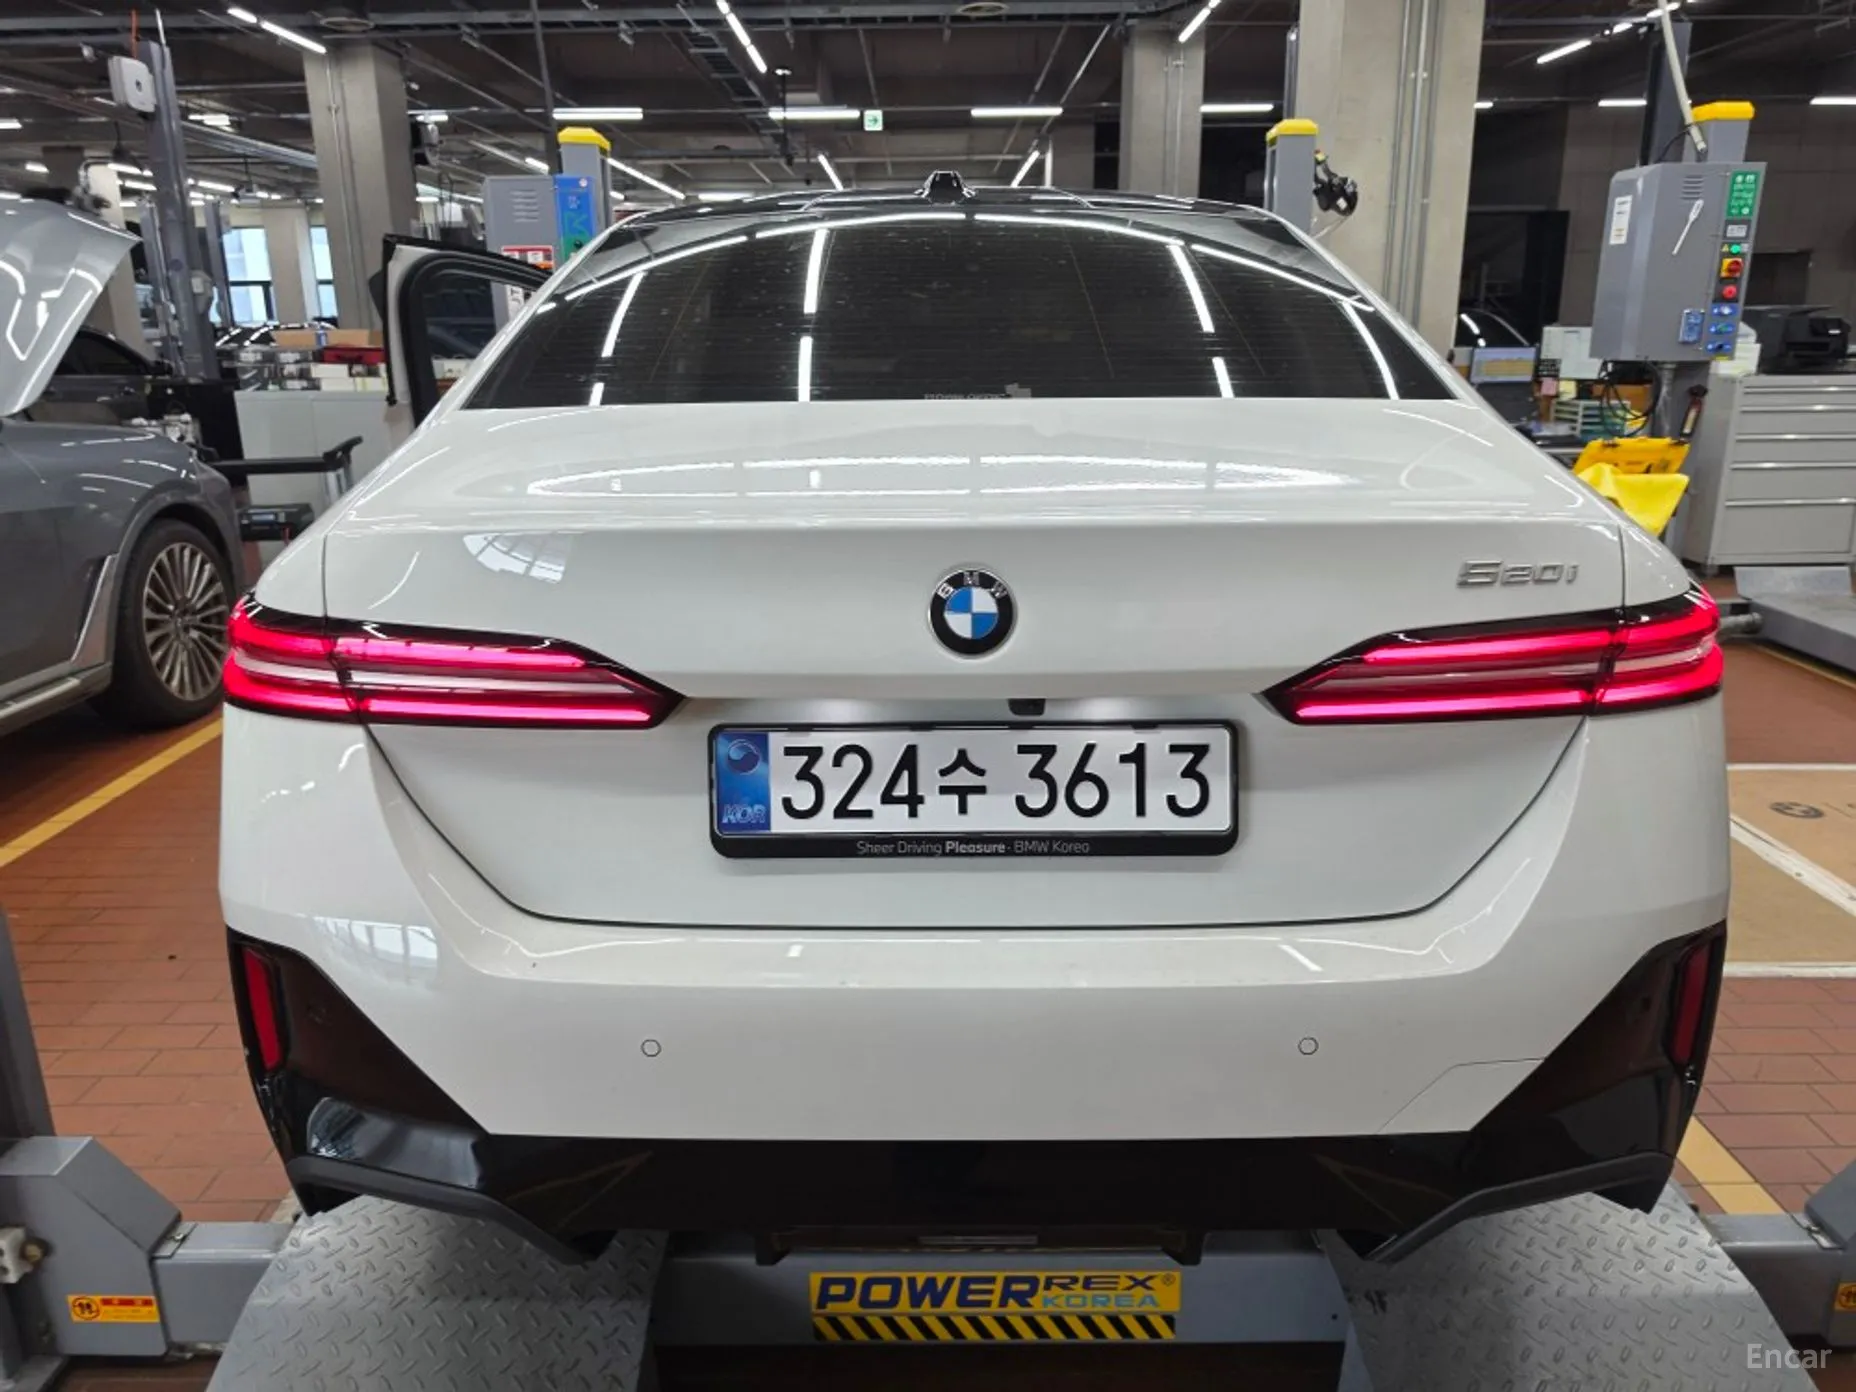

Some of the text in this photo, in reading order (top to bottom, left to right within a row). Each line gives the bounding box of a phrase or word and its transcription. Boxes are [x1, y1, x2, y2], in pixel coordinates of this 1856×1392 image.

[1456, 560, 1579, 586] 520i
[936, 571, 1009, 600] BMW
[781, 741, 1211, 820] 324수 3613
[721, 803, 767, 824] KOR
[856, 839, 1091, 857] Sheer Driving Pleasure BMW Korea
[1041, 1293, 1162, 1309] KOREA
